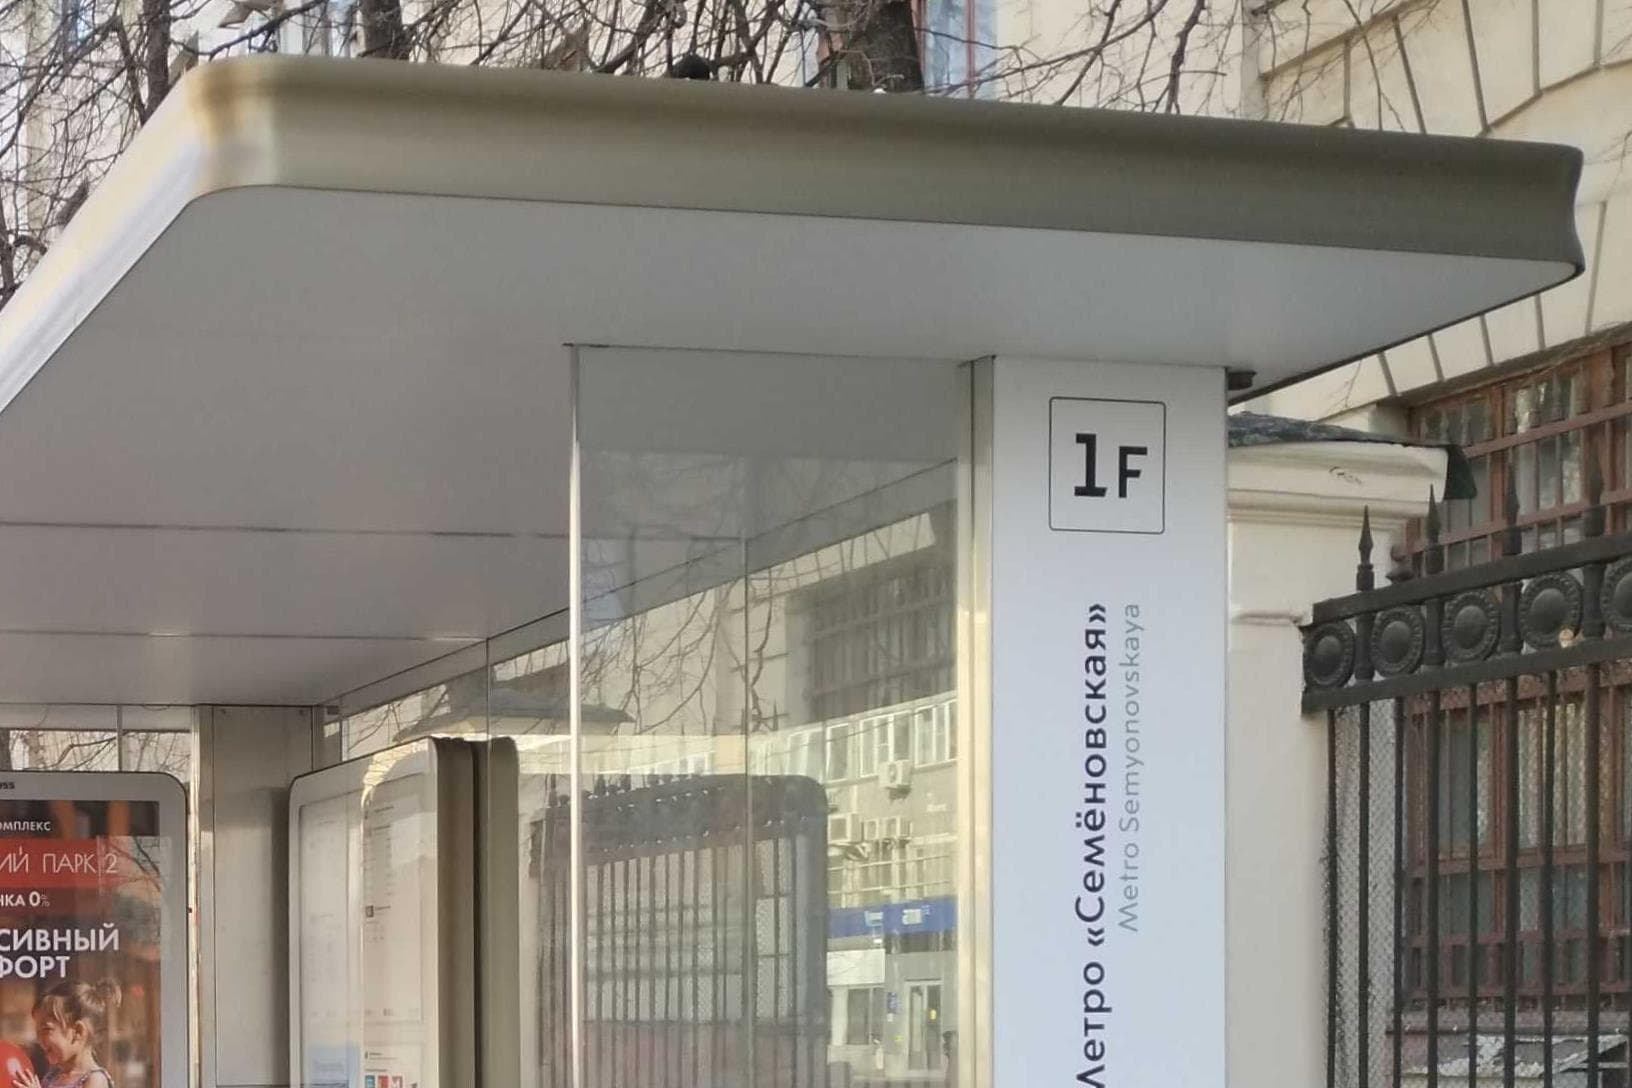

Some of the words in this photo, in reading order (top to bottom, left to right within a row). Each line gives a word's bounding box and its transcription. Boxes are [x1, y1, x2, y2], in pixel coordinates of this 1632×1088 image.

[1074, 603, 1107, 946] «Семёновская»
[1118, 603, 1145, 833] Semyonovskaya
[42, 853, 97, 874] ПАРК
[105, 853, 118, 874] 2
[1117, 842, 1139, 932] Metro
